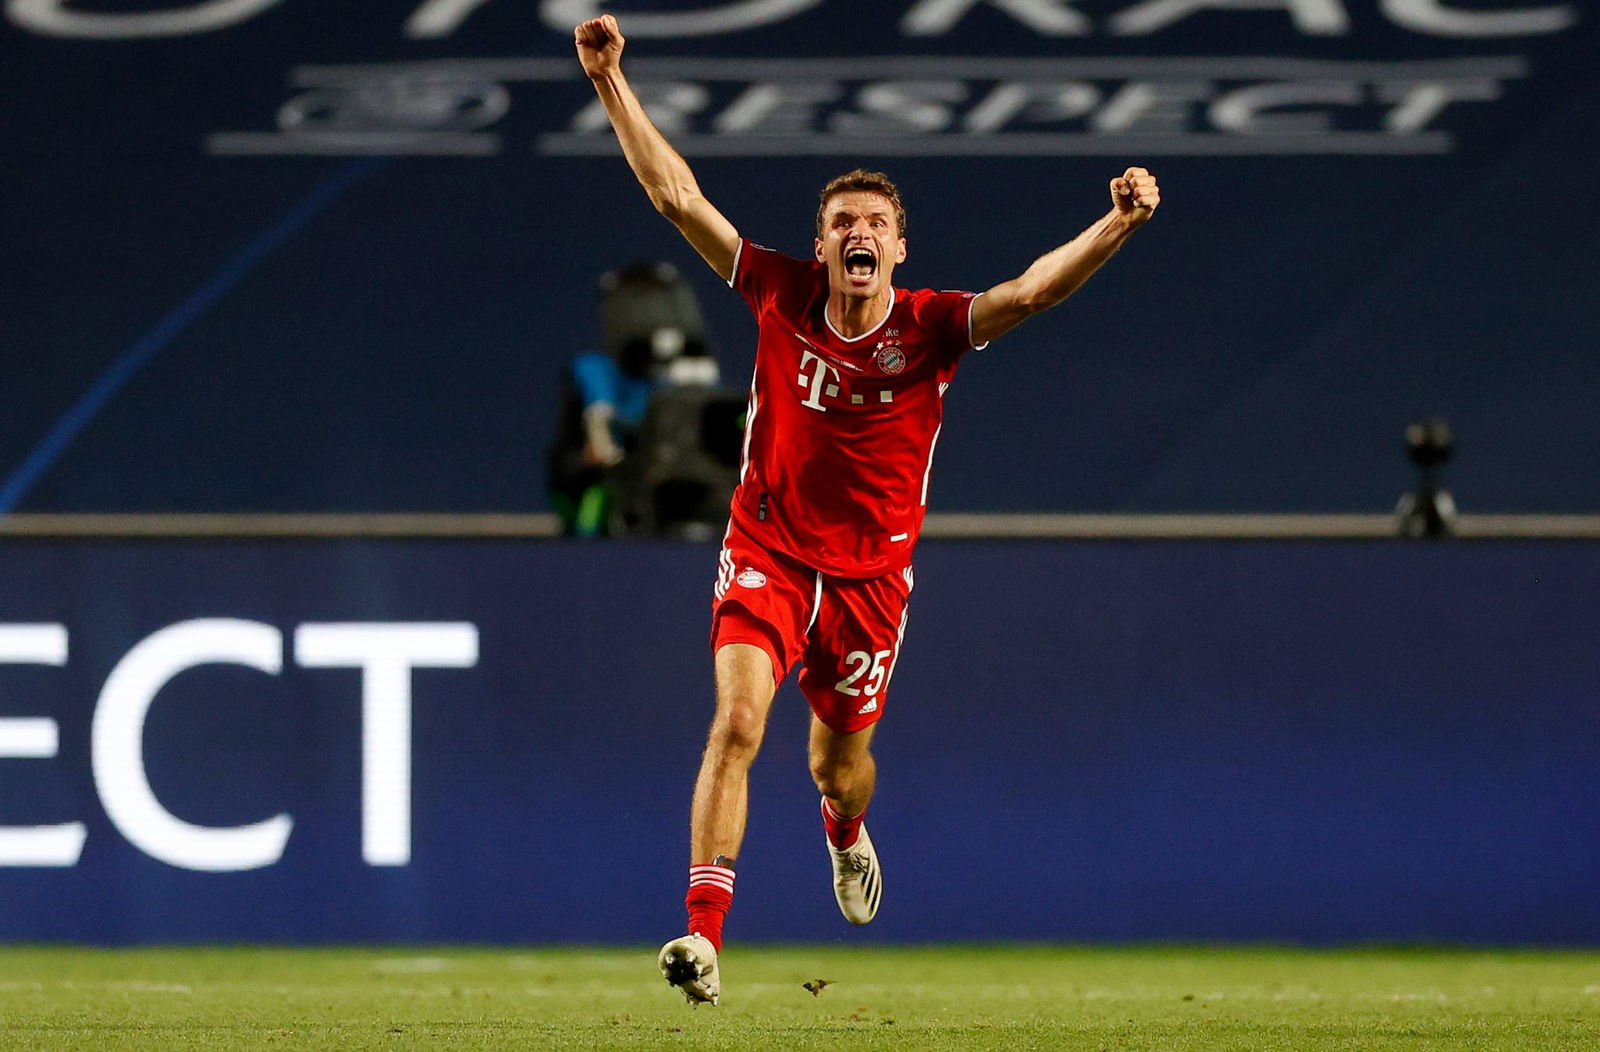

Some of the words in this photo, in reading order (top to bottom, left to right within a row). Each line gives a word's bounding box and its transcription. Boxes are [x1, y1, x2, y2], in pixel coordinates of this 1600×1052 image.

[572, 80, 1500, 134] RESPECT
[800, 350, 840, 412] T
[835, 650, 891, 697] 25
